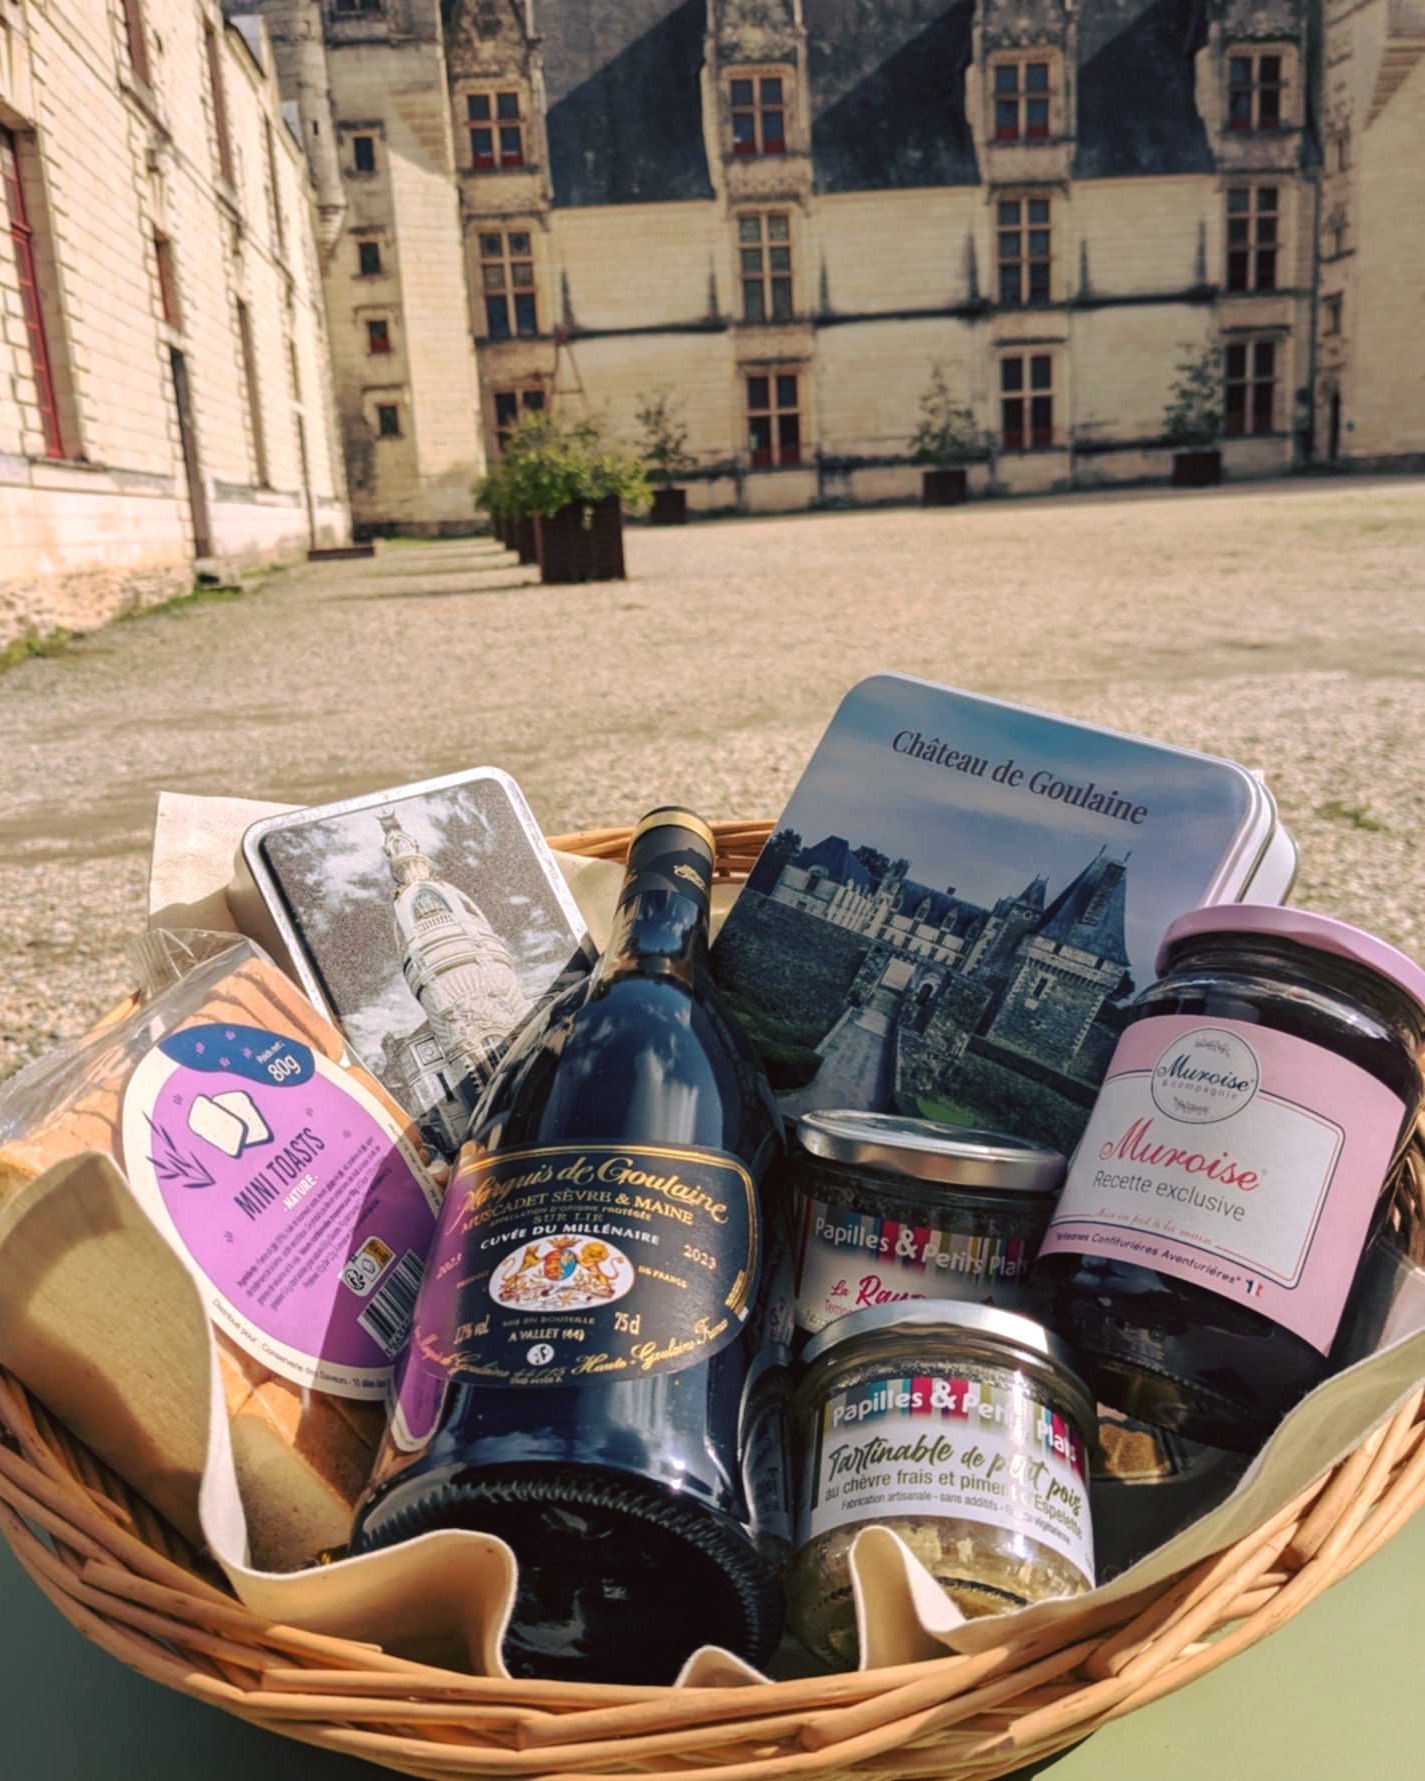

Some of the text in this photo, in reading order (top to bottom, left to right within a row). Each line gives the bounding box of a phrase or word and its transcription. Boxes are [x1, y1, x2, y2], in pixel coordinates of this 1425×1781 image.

[892, 730, 1148, 825] Château de Goulaine
[267, 1055, 301, 1082] 80g
[1157, 1053, 1250, 1091] Muroise
[1171, 1082, 1239, 1100] compagnie
[1099, 1117, 1260, 1192] Muroise
[233, 1127, 326, 1222] MINI TOASTS
[556, 1156, 594, 1185] de
[597, 1157, 729, 1225] Goulaine
[552, 1187, 613, 1203] SÈVRE
[615, 1193, 631, 1206] &
[634, 1195, 695, 1226] MAINE
[1092, 1170, 1246, 1222] Recette exclusive
[480, 1222, 660, 1250] CUVÉE DU MILLÉNAIRE
[532, 1212, 603, 1224] SUR LIE
[683, 1243, 717, 1271] 2023
[815, 1217, 1029, 1276] Papilles & Petits Plats
[830, 1279, 848, 1296] La
[519, 1327, 560, 1340] VALLET
[833, 1389, 923, 1427] Papilles
[930, 1377, 957, 1410] &
[828, 1434, 953, 1482] Tartinable
[961, 1445, 985, 1470] de
[825, 1487, 839, 1502] au
[843, 1472, 891, 1495] chèvre
[896, 1467, 933, 1485] frais
[938, 1471, 955, 1486] et
